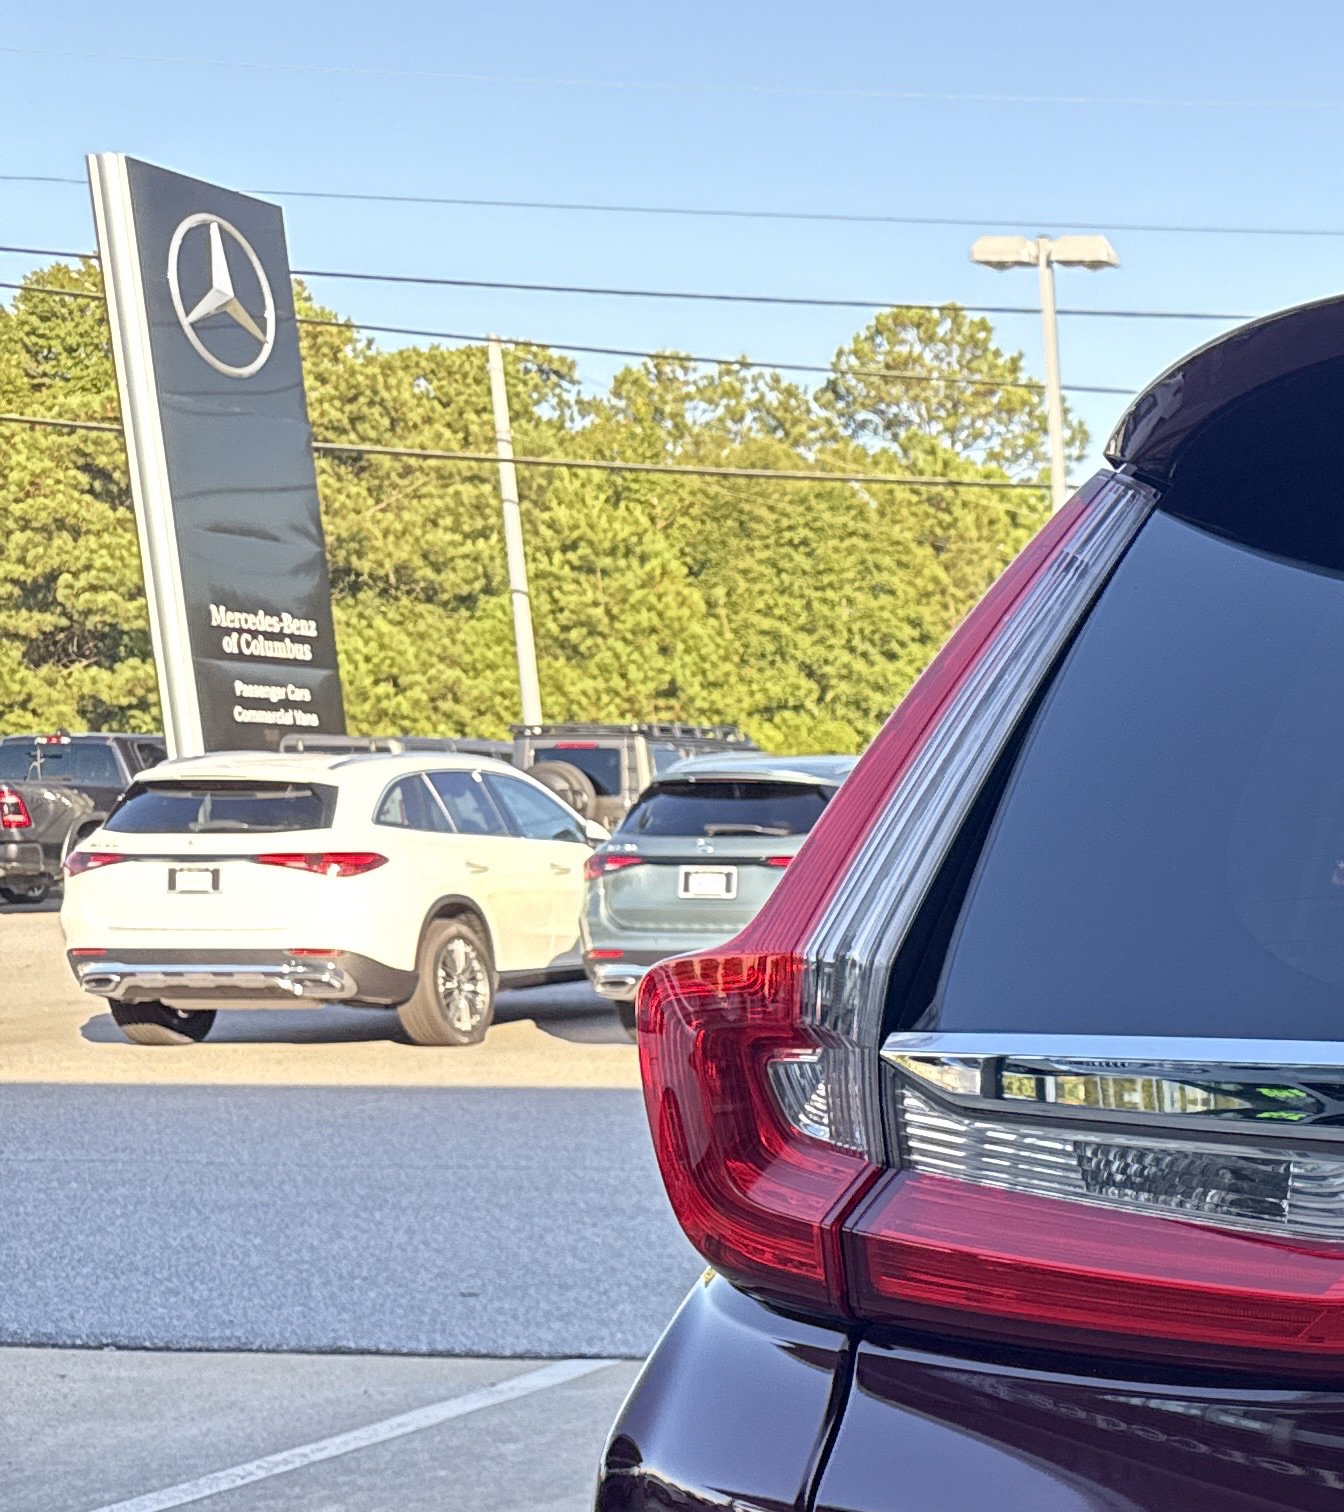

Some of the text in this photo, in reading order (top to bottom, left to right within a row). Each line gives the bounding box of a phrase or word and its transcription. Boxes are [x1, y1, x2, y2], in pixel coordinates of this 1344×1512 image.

[209, 603, 318, 637] Mercedes-Benz
[222, 632, 312, 661] of Columbus
